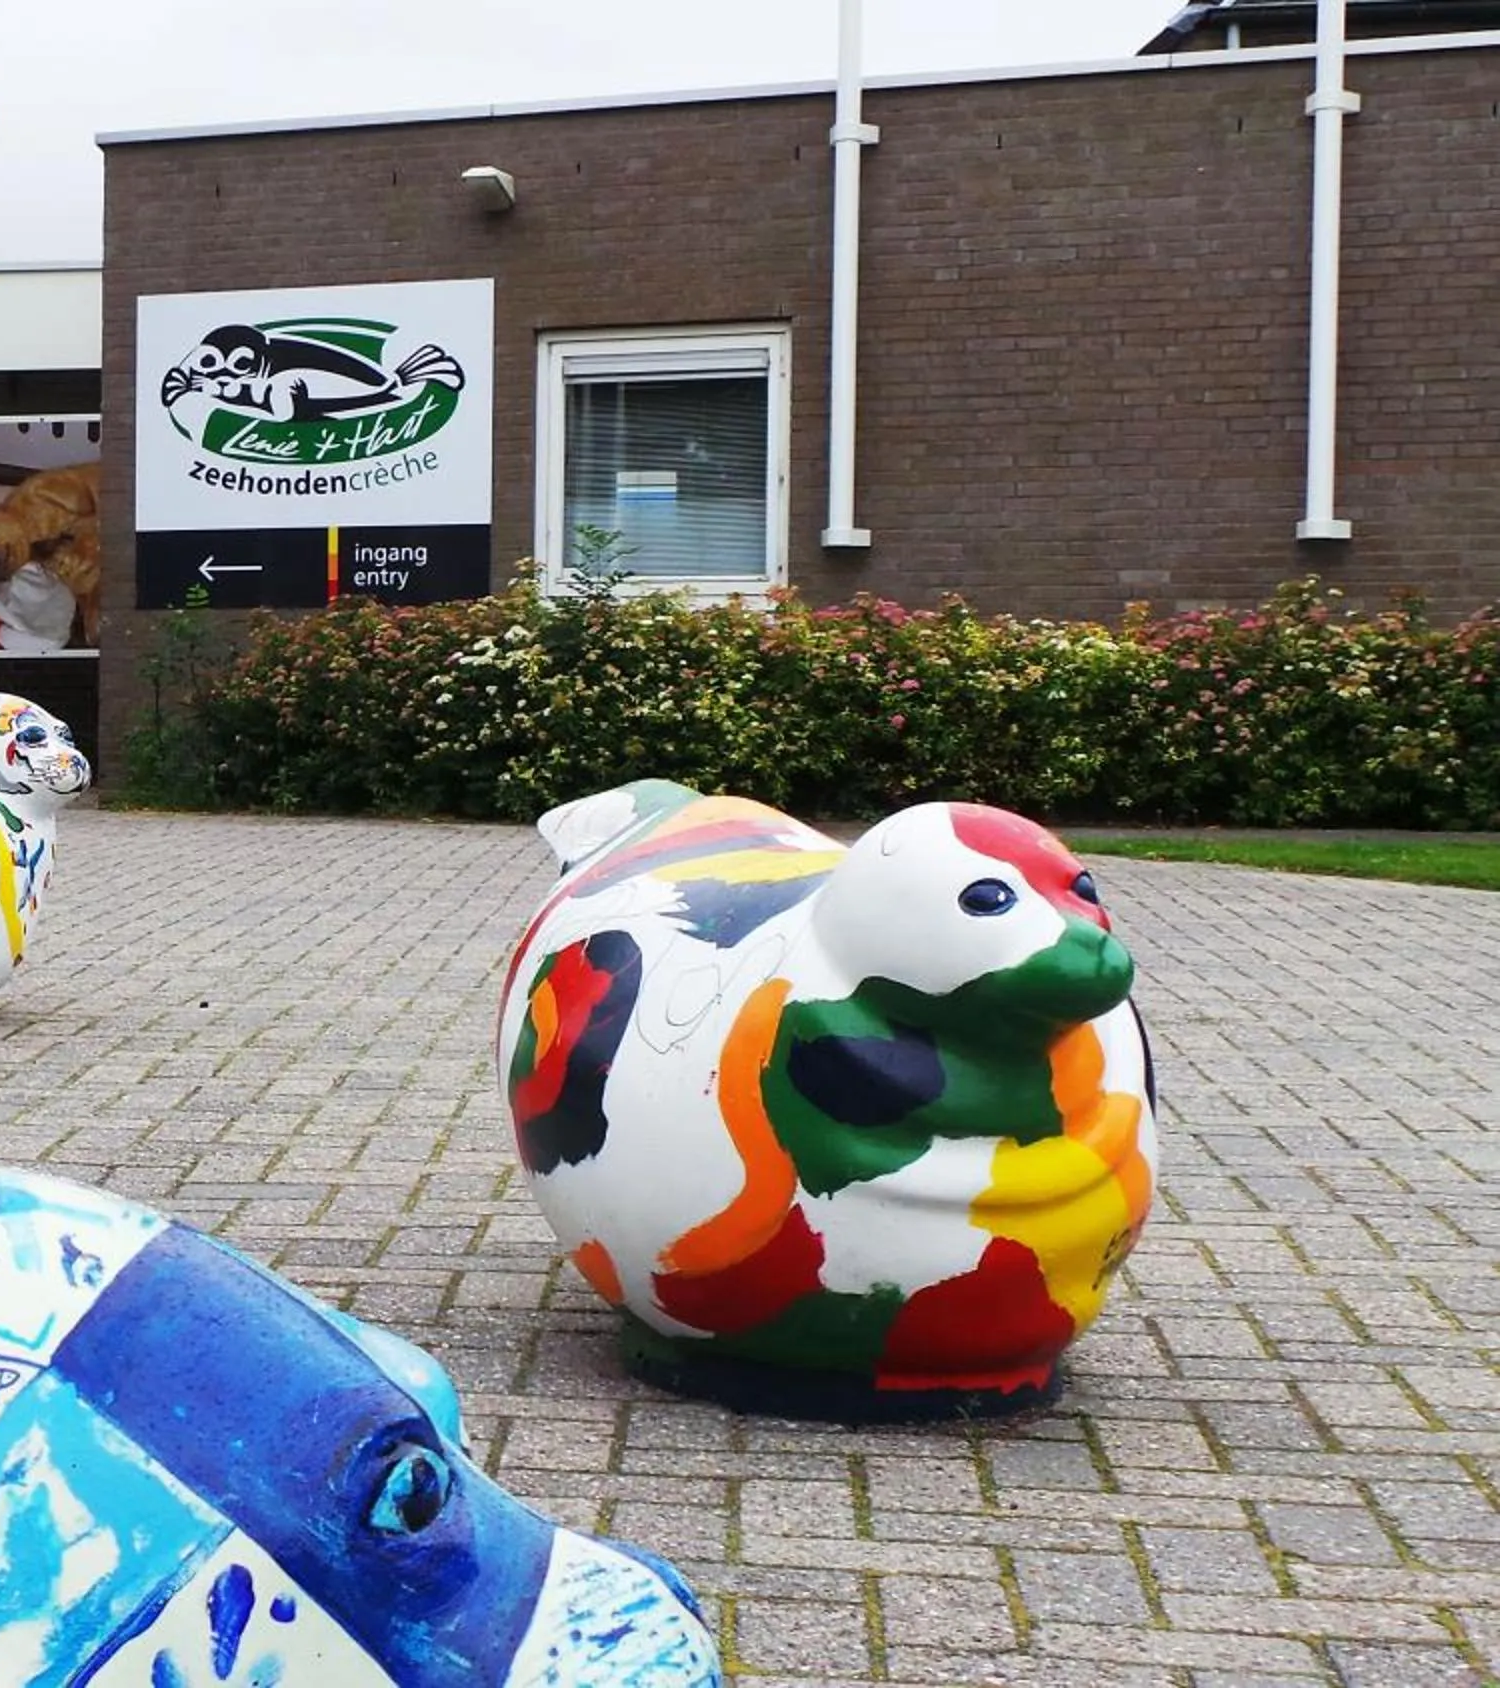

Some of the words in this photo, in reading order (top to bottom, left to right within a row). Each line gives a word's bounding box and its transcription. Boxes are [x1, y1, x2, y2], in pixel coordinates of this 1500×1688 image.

[221, 419, 303, 463] Lenie
[343, 394, 439, 459] Hart
[188, 449, 439, 495] zeehondencrèche
[353, 543, 428, 567] ingang
[353, 570, 410, 591] entry
